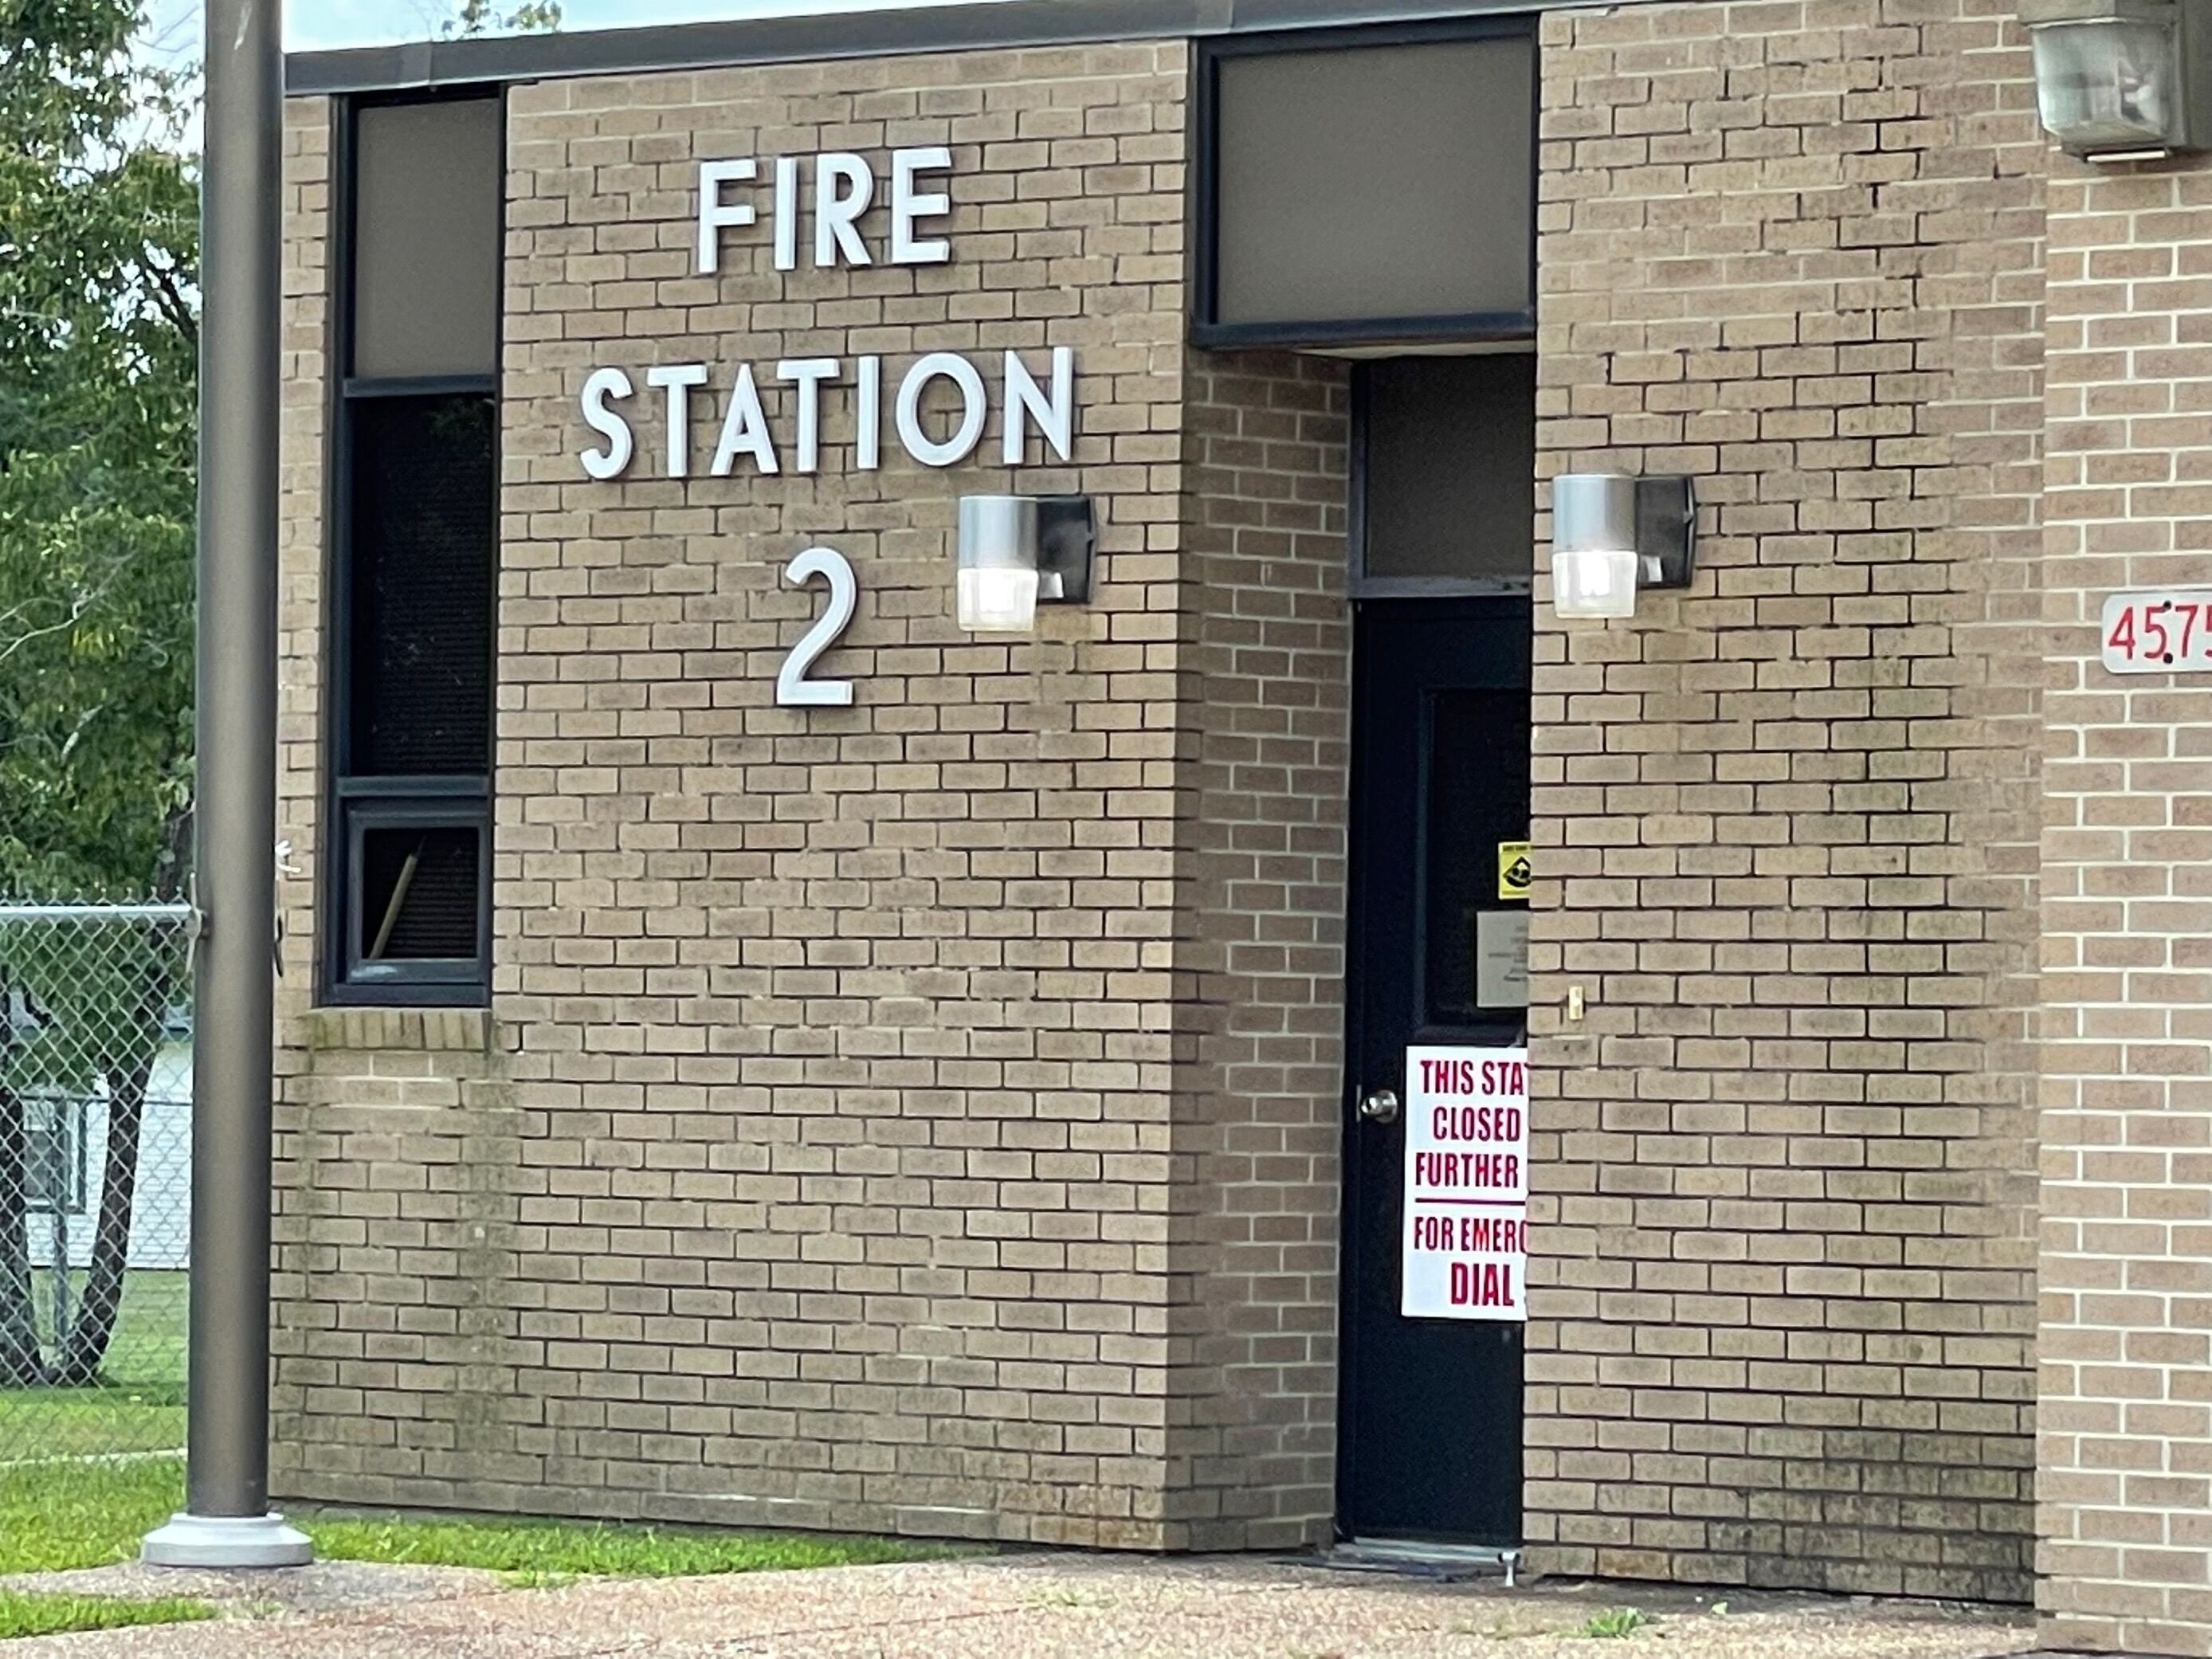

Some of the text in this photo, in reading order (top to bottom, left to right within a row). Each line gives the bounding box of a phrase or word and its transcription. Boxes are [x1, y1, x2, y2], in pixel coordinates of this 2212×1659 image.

[698, 146, 952, 274] FIRE
[579, 346, 1074, 480] STATION
[775, 546, 858, 707] 2
[1420, 1061, 1528, 1096] THIS STA
[1433, 1106, 1522, 1143] CLOSED
[1414, 1152, 1520, 1189] FURTHER
[1414, 1216, 1454, 1252] FOR
[1450, 1261, 1515, 1308] DIAL
